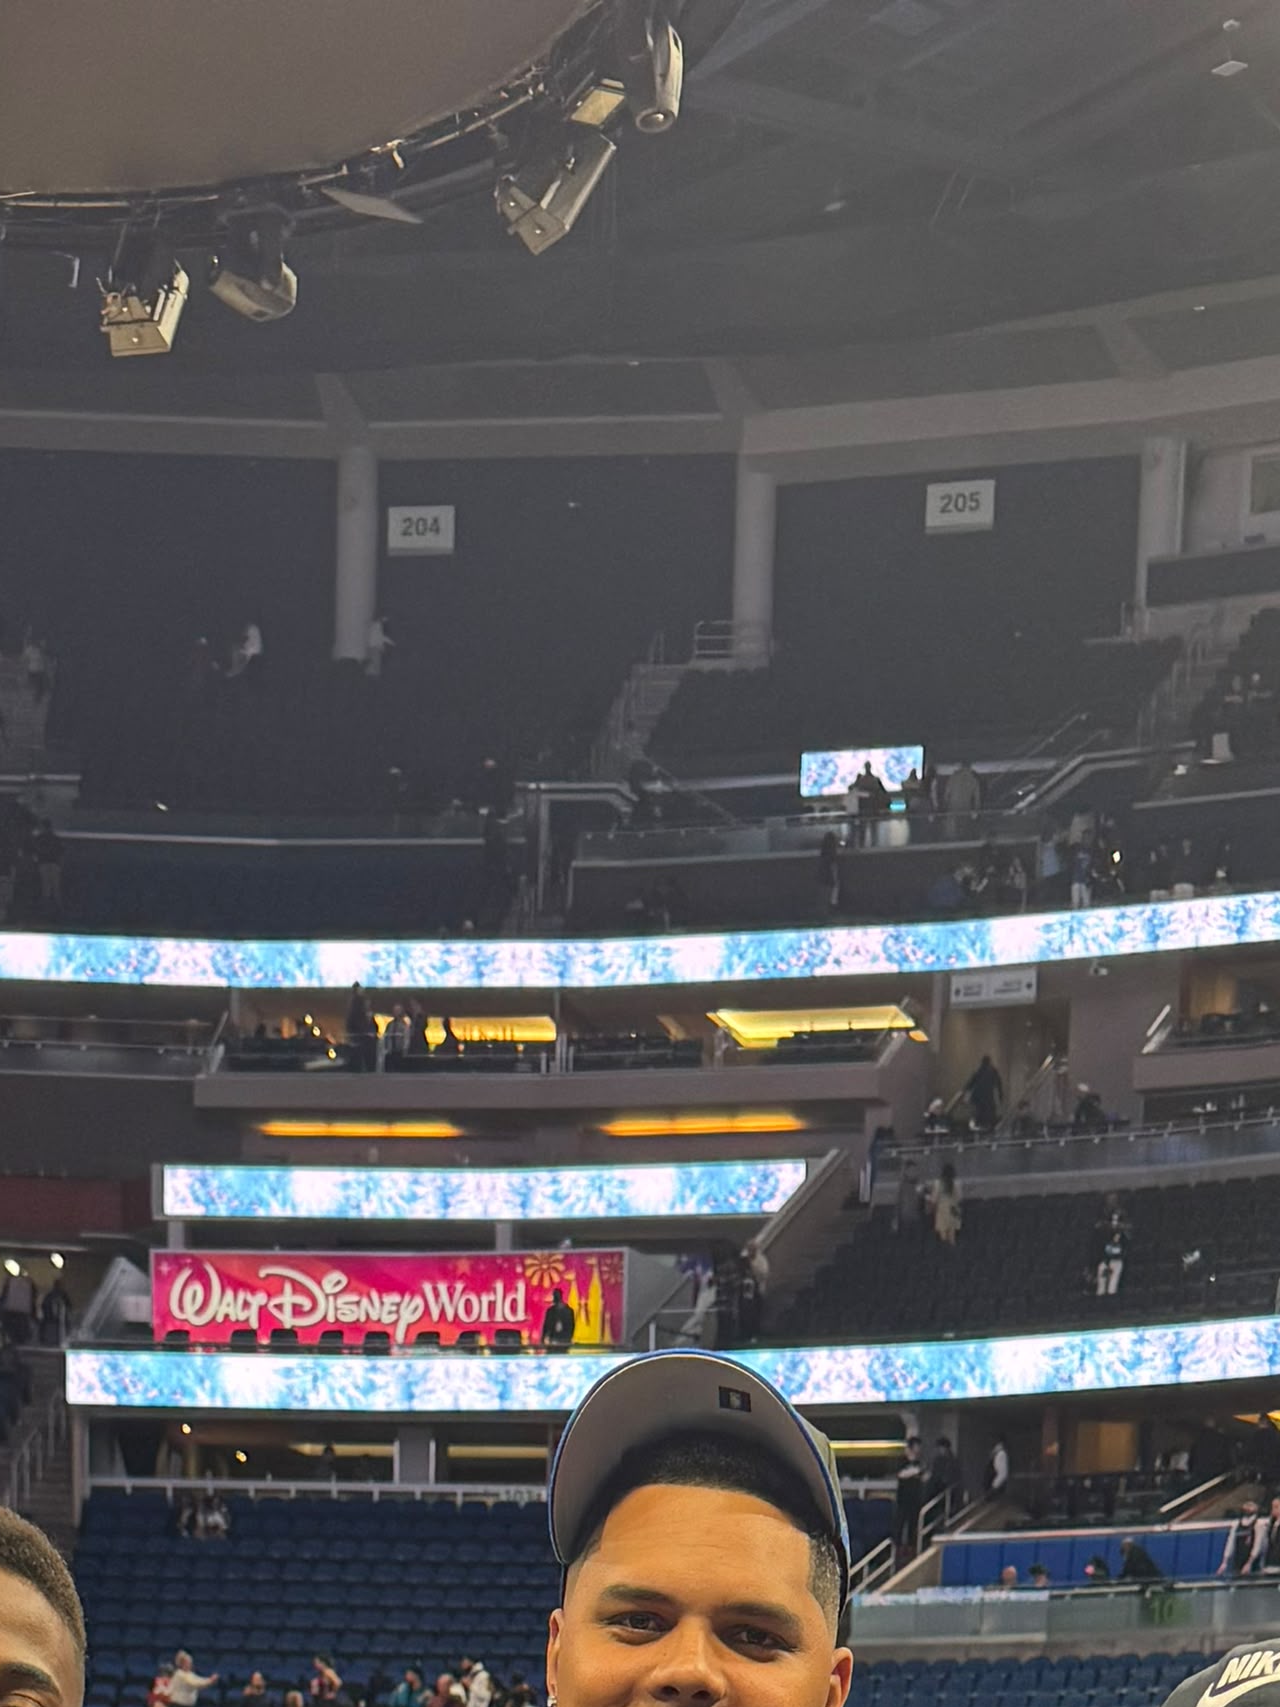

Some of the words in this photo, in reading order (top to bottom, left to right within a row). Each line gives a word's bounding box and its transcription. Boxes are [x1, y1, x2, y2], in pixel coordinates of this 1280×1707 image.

[939, 490, 981, 516] 205
[401, 515, 441, 539] 204
[422, 1278, 528, 1324] World
